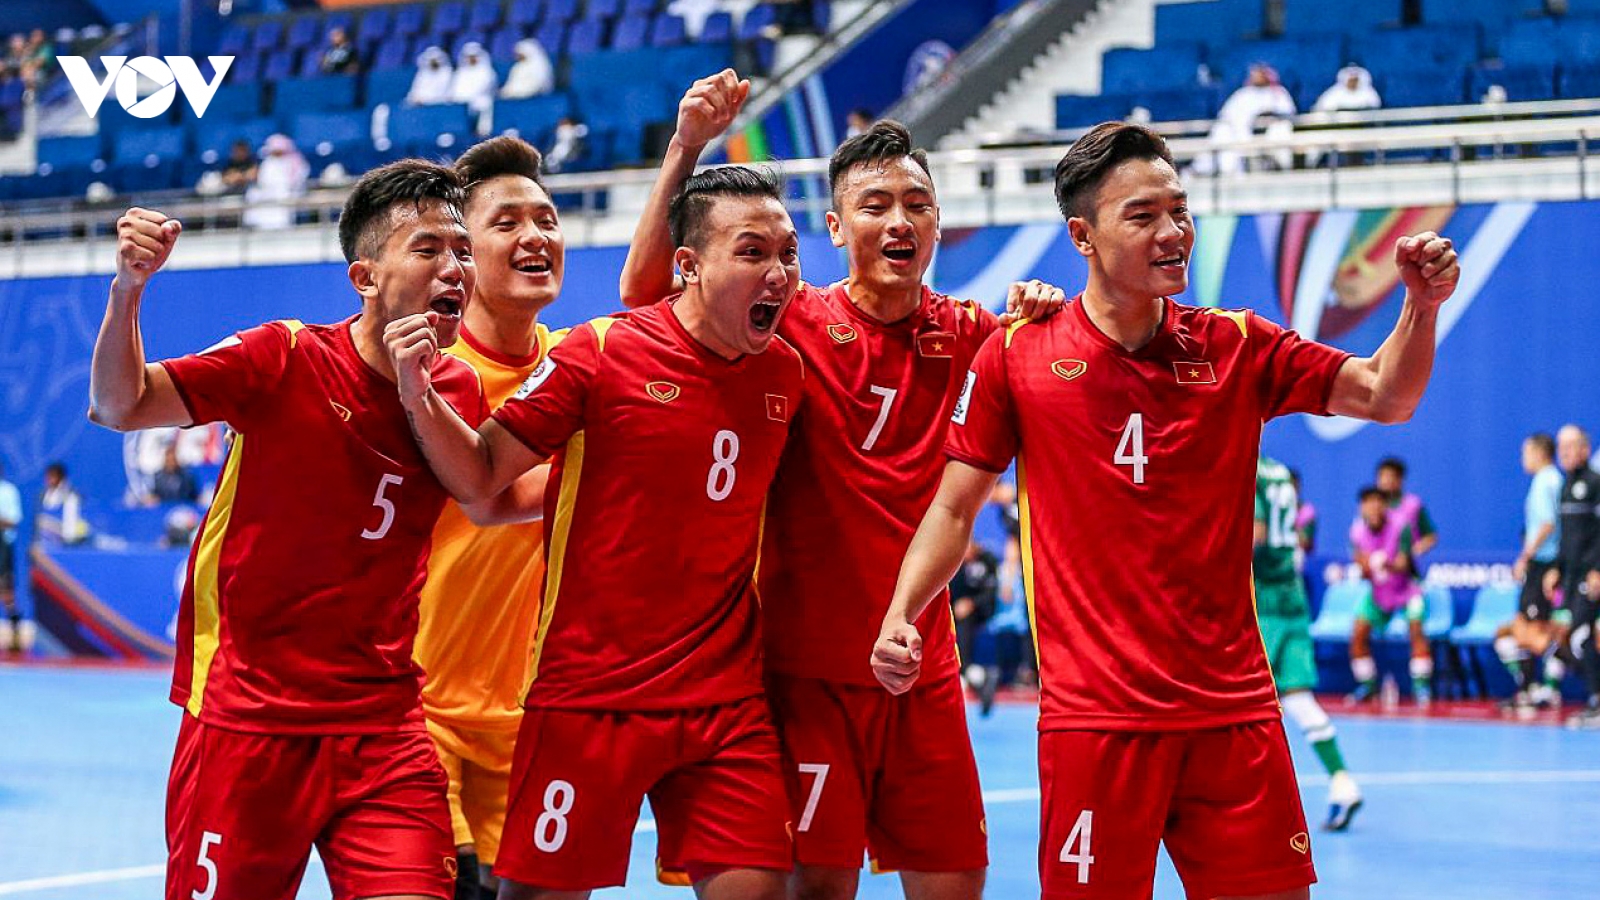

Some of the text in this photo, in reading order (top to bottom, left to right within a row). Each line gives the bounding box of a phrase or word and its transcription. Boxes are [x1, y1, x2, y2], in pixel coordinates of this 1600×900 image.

[862, 384, 898, 452] 7
[1113, 412, 1149, 485] 4
[706, 429, 739, 502] 8
[361, 473, 404, 540] 5
[534, 779, 575, 854] 8
[797, 763, 830, 832] 7
[190, 831, 222, 900] 5
[1059, 809, 1095, 885] 4
